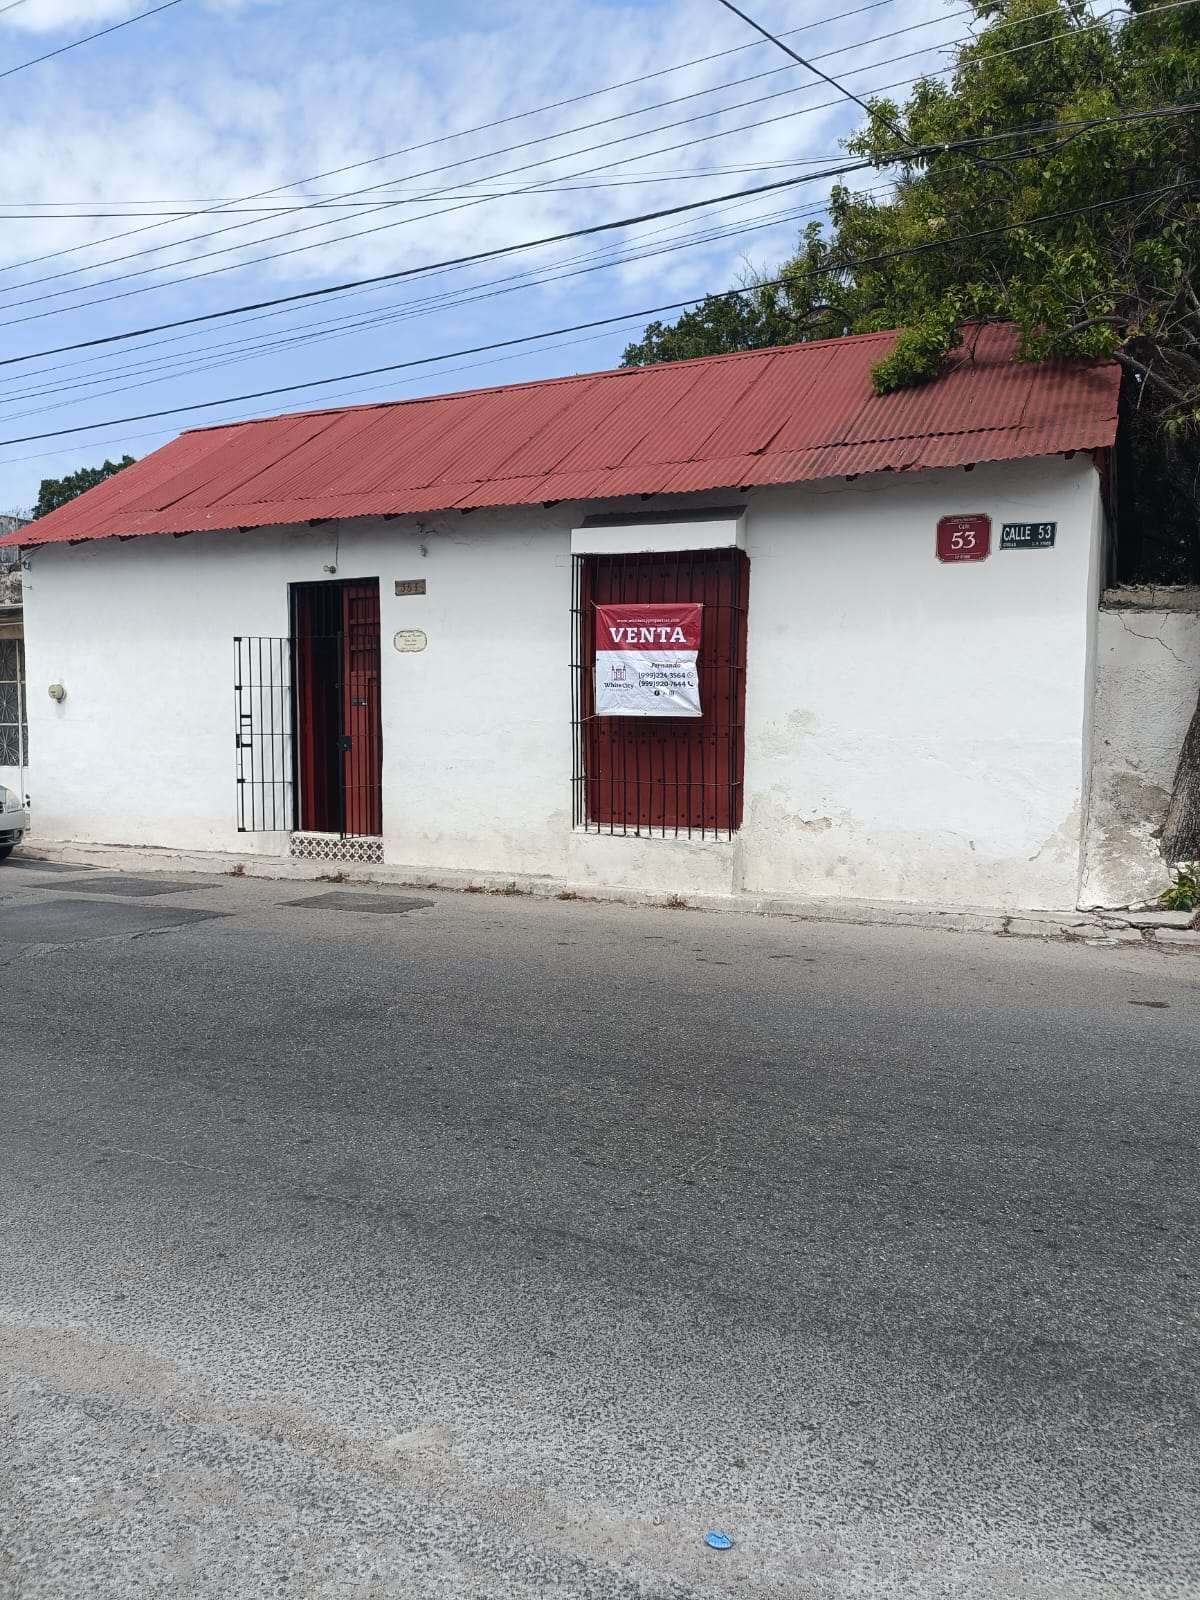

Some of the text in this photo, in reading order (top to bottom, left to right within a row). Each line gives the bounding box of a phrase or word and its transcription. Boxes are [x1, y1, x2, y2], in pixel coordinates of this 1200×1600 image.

[951, 531, 976, 550] 53
[1003, 525, 1052, 541] CALLE 53
[609, 626, 687, 643] VENTA
[650, 661, 682, 669] Fernando
[622, 682, 635, 690] City
